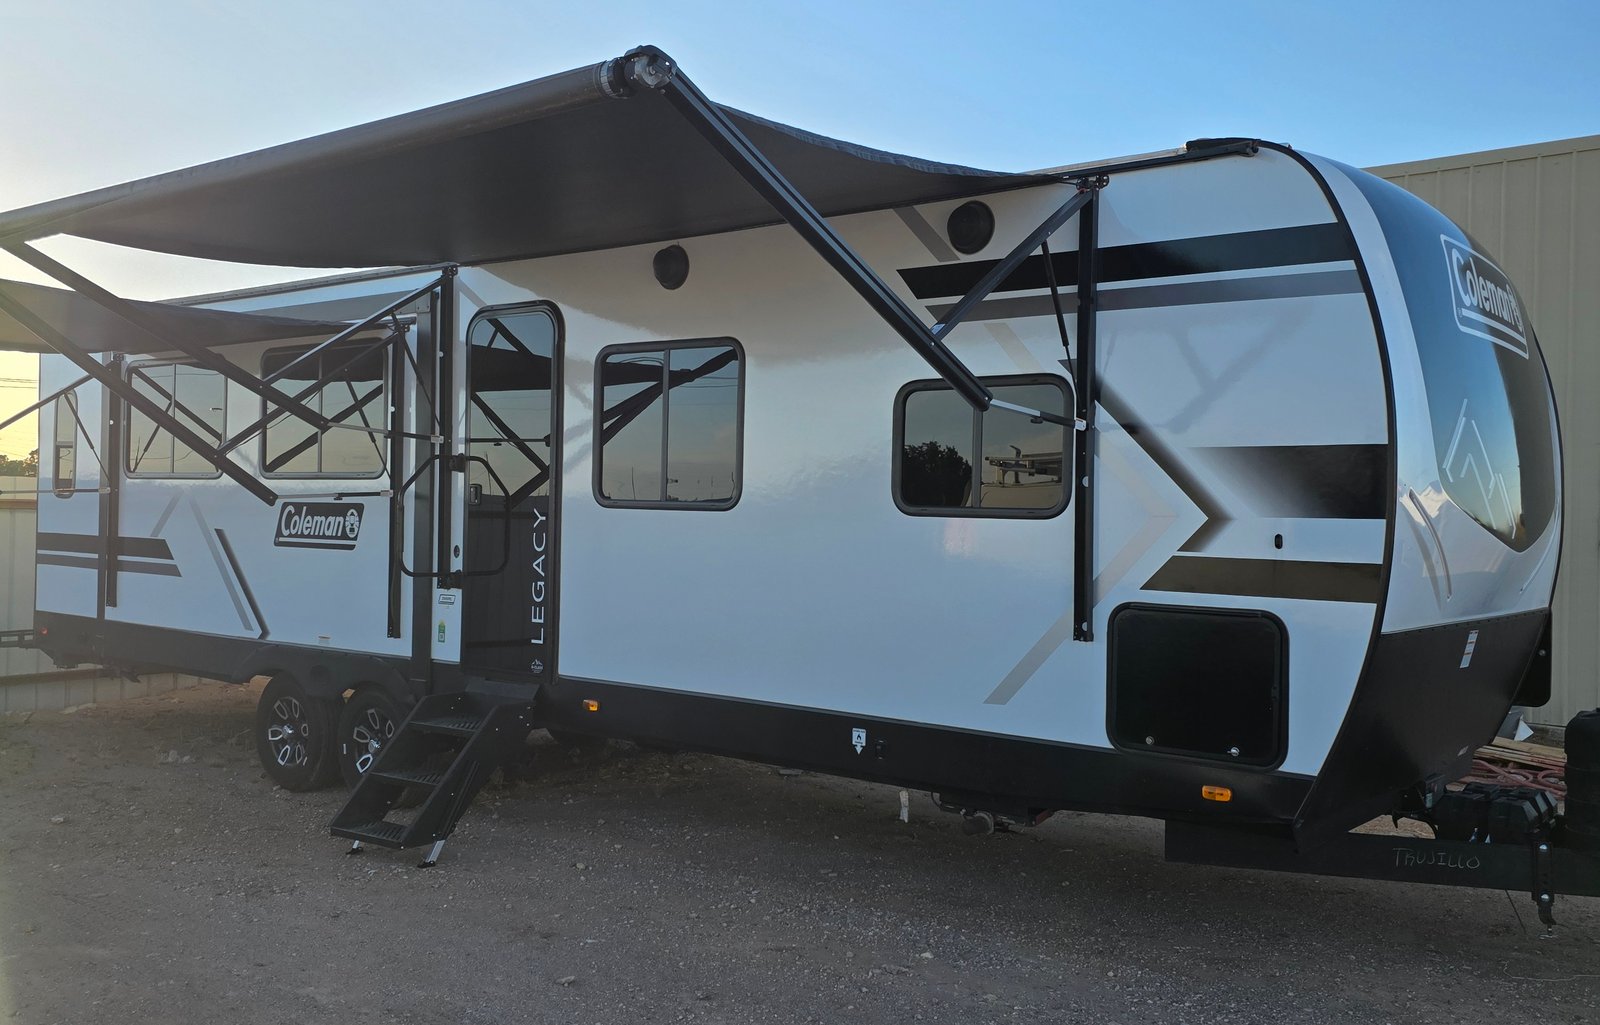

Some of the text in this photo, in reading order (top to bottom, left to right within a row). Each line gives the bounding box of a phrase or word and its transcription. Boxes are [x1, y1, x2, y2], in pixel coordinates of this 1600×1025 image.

[1452, 248, 1515, 325] Coleman
[281, 505, 345, 537] Coleman
[531, 508, 547, 645] LEGACY
[1392, 847, 1480, 869] TRUJILLO
